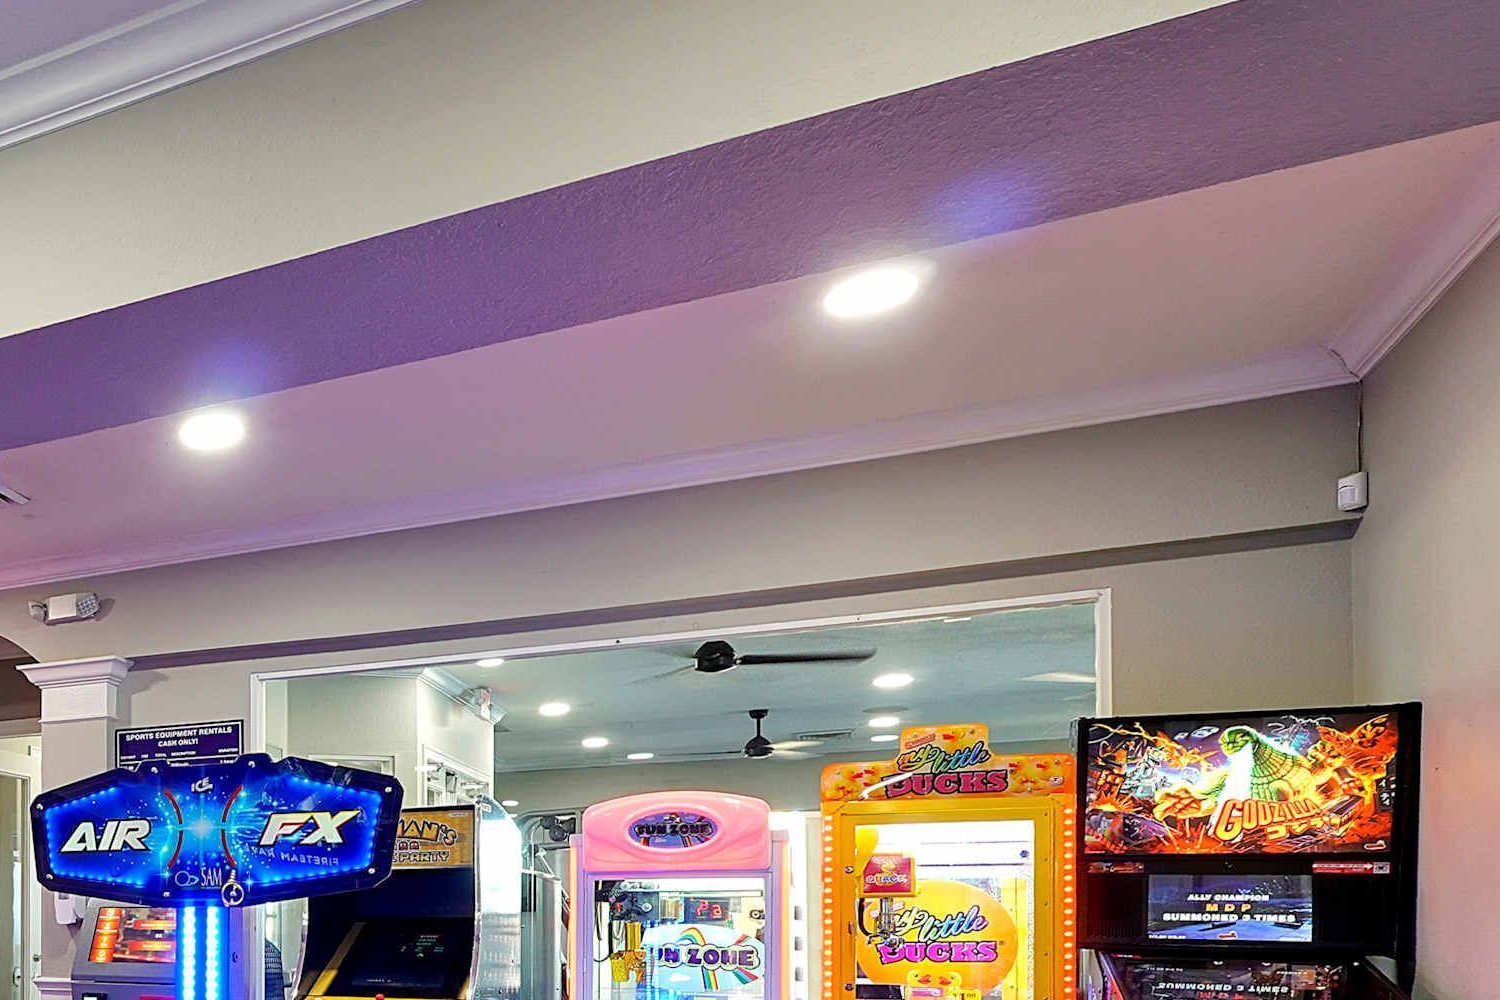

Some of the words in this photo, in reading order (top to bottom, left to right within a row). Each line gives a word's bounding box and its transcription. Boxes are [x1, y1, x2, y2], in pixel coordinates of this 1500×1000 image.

[125, 732, 154, 741] SPORTS
[155, 729, 197, 739] EQUIPMENT
[198, 726, 233, 735] RENTALS
[157, 739, 177, 747] CASH
[190, 776, 214, 794] ICE
[881, 769, 1010, 798] DUCKS
[259, 809, 362, 847] FX
[1215, 797, 1322, 842] GODZILLA
[60, 818, 153, 853] AIR
[636, 823, 667, 837] FUN
[668, 821, 713, 836] ZONE
[400, 850, 450, 862] PARTY
[1213, 894, 1270, 902] CHAMPION
[1205, 903, 1219, 912] M
[1224, 903, 1236, 912] D
[1241, 903, 1251, 912] P
[918, 905, 990, 942] little
[1163, 913, 1238, 922] SUMMONED
[1253, 914, 1296, 923] TIMES
[687, 948, 754, 967] ZONE
[875, 941, 998, 965] DUCKS
